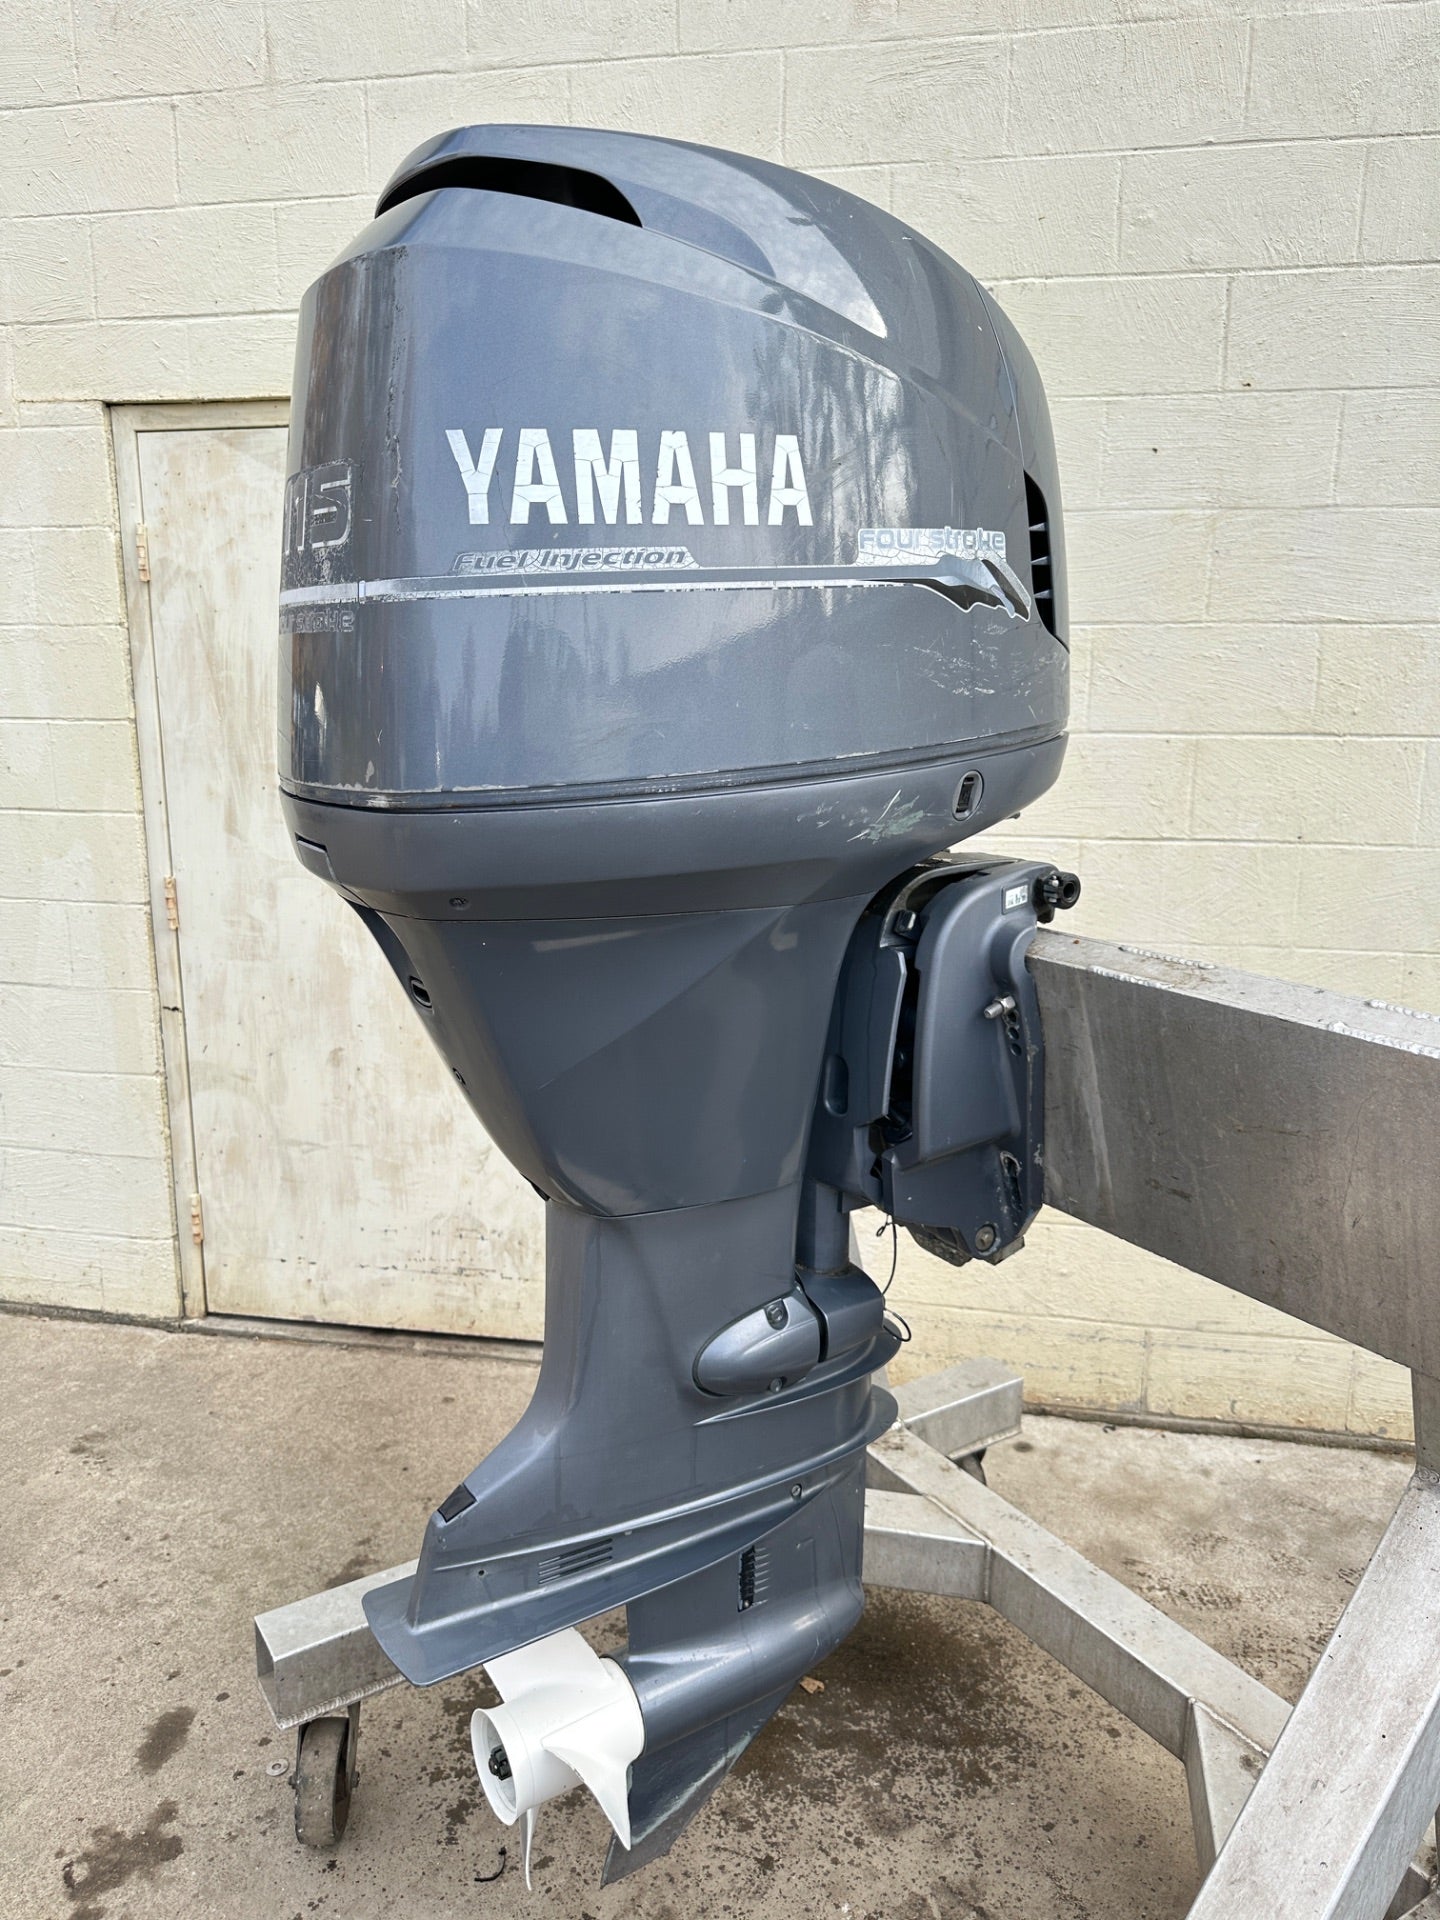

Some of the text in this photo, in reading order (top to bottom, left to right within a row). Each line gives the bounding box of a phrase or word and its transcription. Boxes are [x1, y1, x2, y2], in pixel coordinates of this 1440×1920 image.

[445, 428, 814, 527] YAMAHA
[453, 547, 687, 572] Fuel Injection
